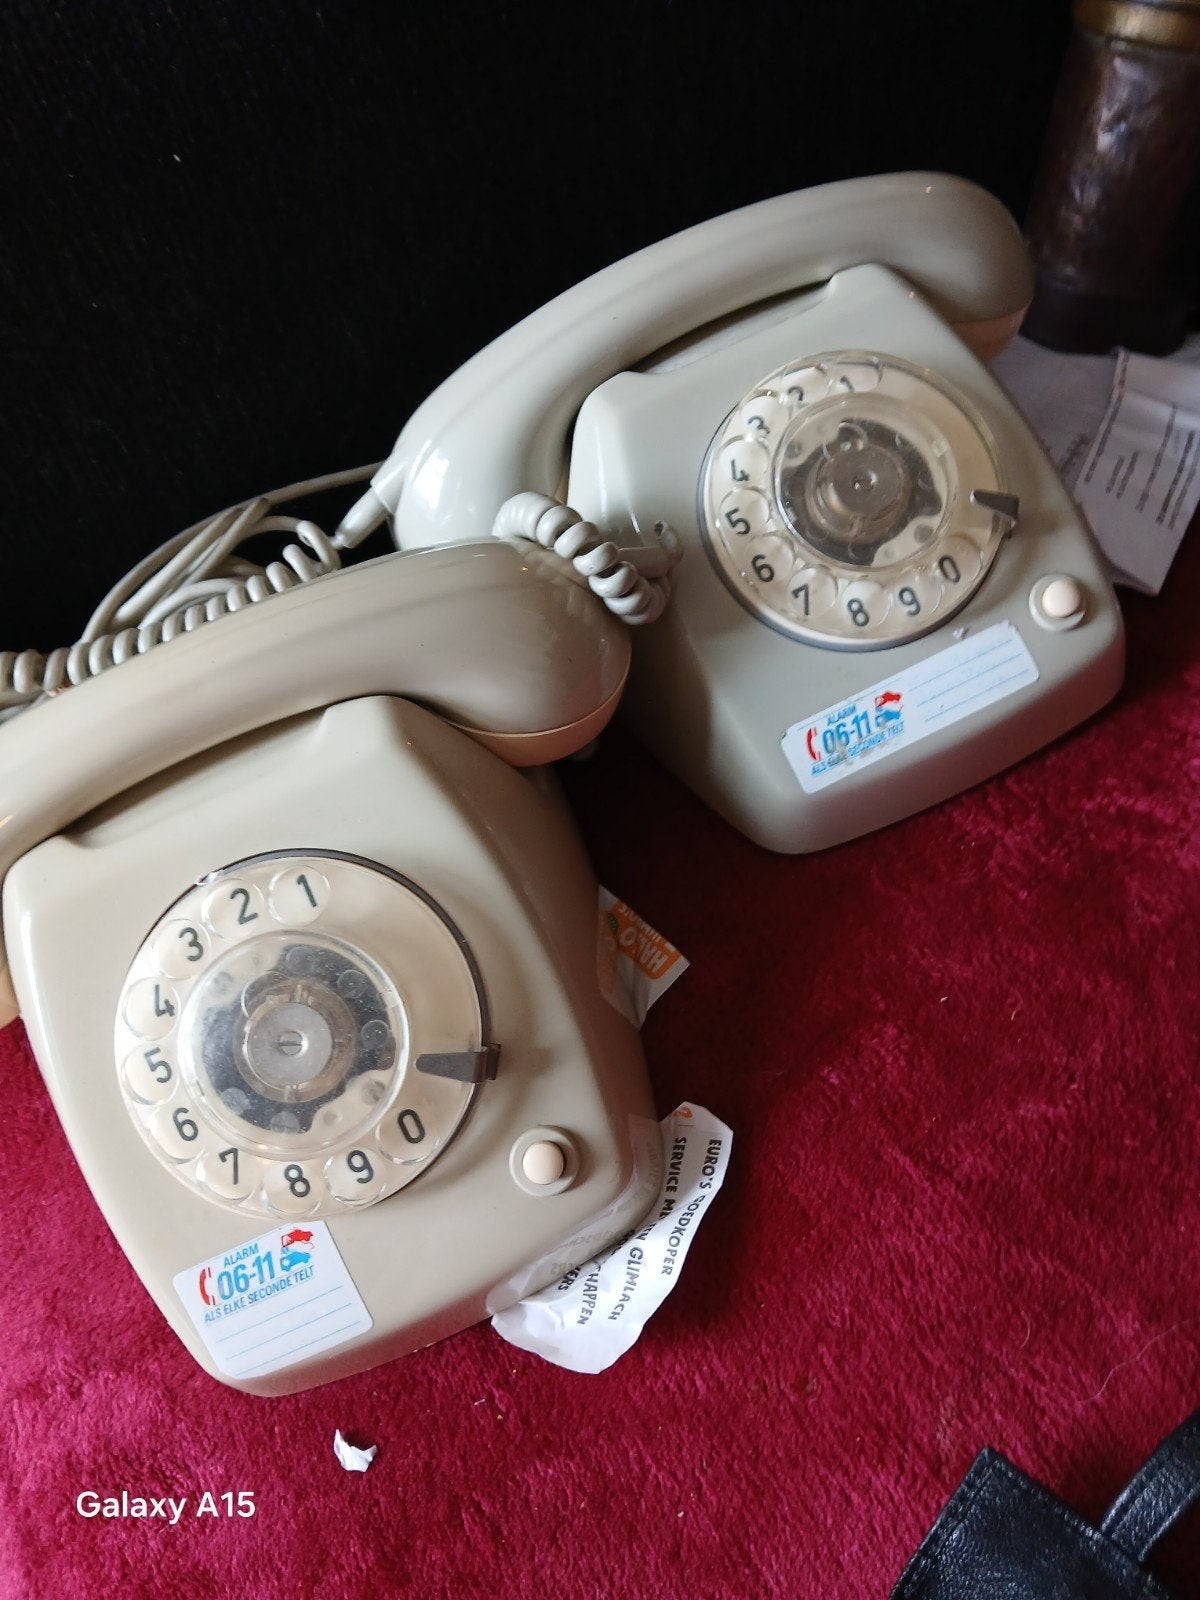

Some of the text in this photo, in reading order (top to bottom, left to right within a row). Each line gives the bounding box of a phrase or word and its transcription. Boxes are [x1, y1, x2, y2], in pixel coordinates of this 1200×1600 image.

[730, 459, 749, 482] 4
[725, 508, 751, 535] 5
[751, 554, 775, 583] 6
[937, 554, 961, 583] 0
[792, 583, 810, 616] 7
[847, 598, 870, 627] 8
[898, 586, 922, 616] 9
[822, 710, 871, 754] 06-11
[229, 887, 259, 926] 2
[296, 873, 318, 908] 1
[178, 926, 204, 962] 3
[153, 983, 175, 1018] 4
[143, 1048, 173, 1083] 5
[173, 1106, 199, 1141] 6
[397, 1108, 425, 1144] 0
[218, 1147, 241, 1186] 7
[284, 1164, 311, 1198] 8
[346, 1149, 375, 1185] 9
[665, 1136, 687, 1193] SERVICE
[699, 1138, 722, 1190] EURO'S
[224, 1243, 260, 1268] ALARM
[217, 1251, 276, 1301] 06-11
[608, 1246, 644, 1321] GLIMLACH
[204, 1264, 315, 1324] ALS ELKE SECONDE TELT
